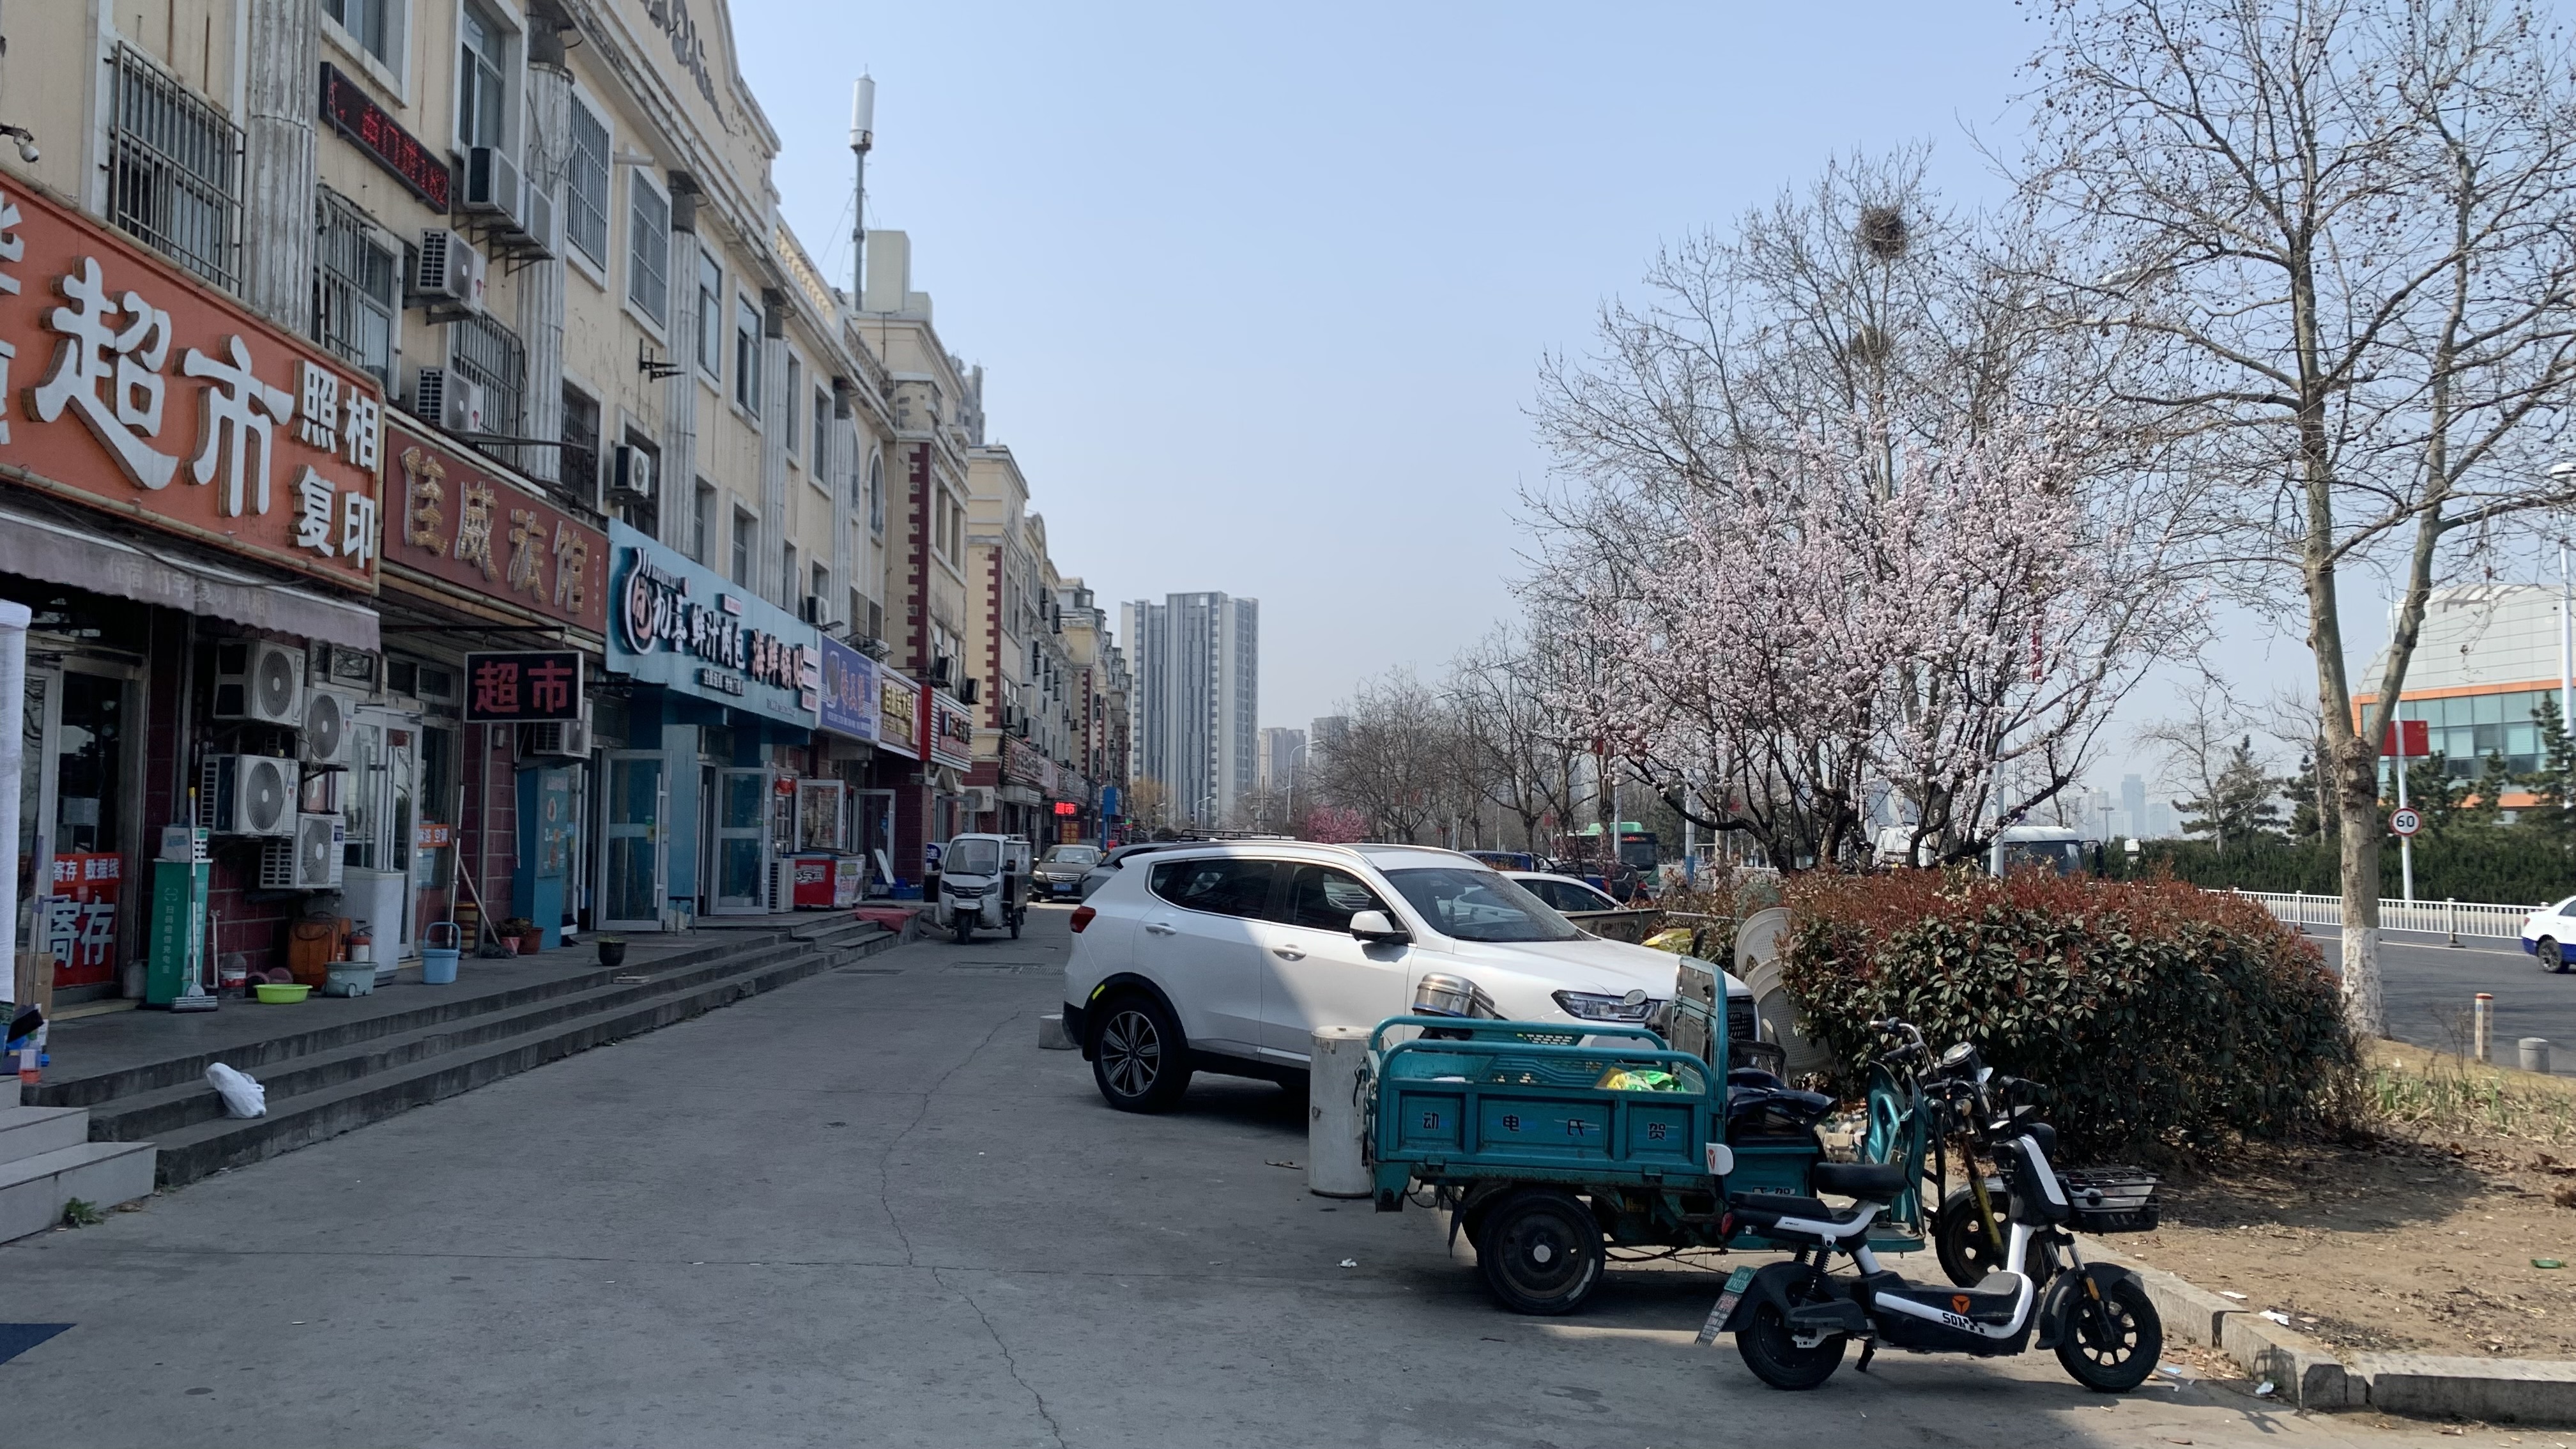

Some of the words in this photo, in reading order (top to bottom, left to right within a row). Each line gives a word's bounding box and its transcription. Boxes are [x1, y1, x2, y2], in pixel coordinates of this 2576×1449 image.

[35, 256, 294, 518] 超市
[303, 360, 378, 473] 照相
[297, 466, 376, 569] 复印
[401, 447, 588, 614] 佳威旅馆
[474, 659, 573, 714] 超市
[691, 603, 746, 670] 鲜汁肉包
[752, 629, 804, 691] 海鲜锅贴
[1055, 801, 1076, 815] 超市
[2396, 815, 2415, 828] 60
[54, 858, 77, 882] 寄存
[84, 858, 120, 880] 数据线
[51, 895, 115, 968] 寄存
